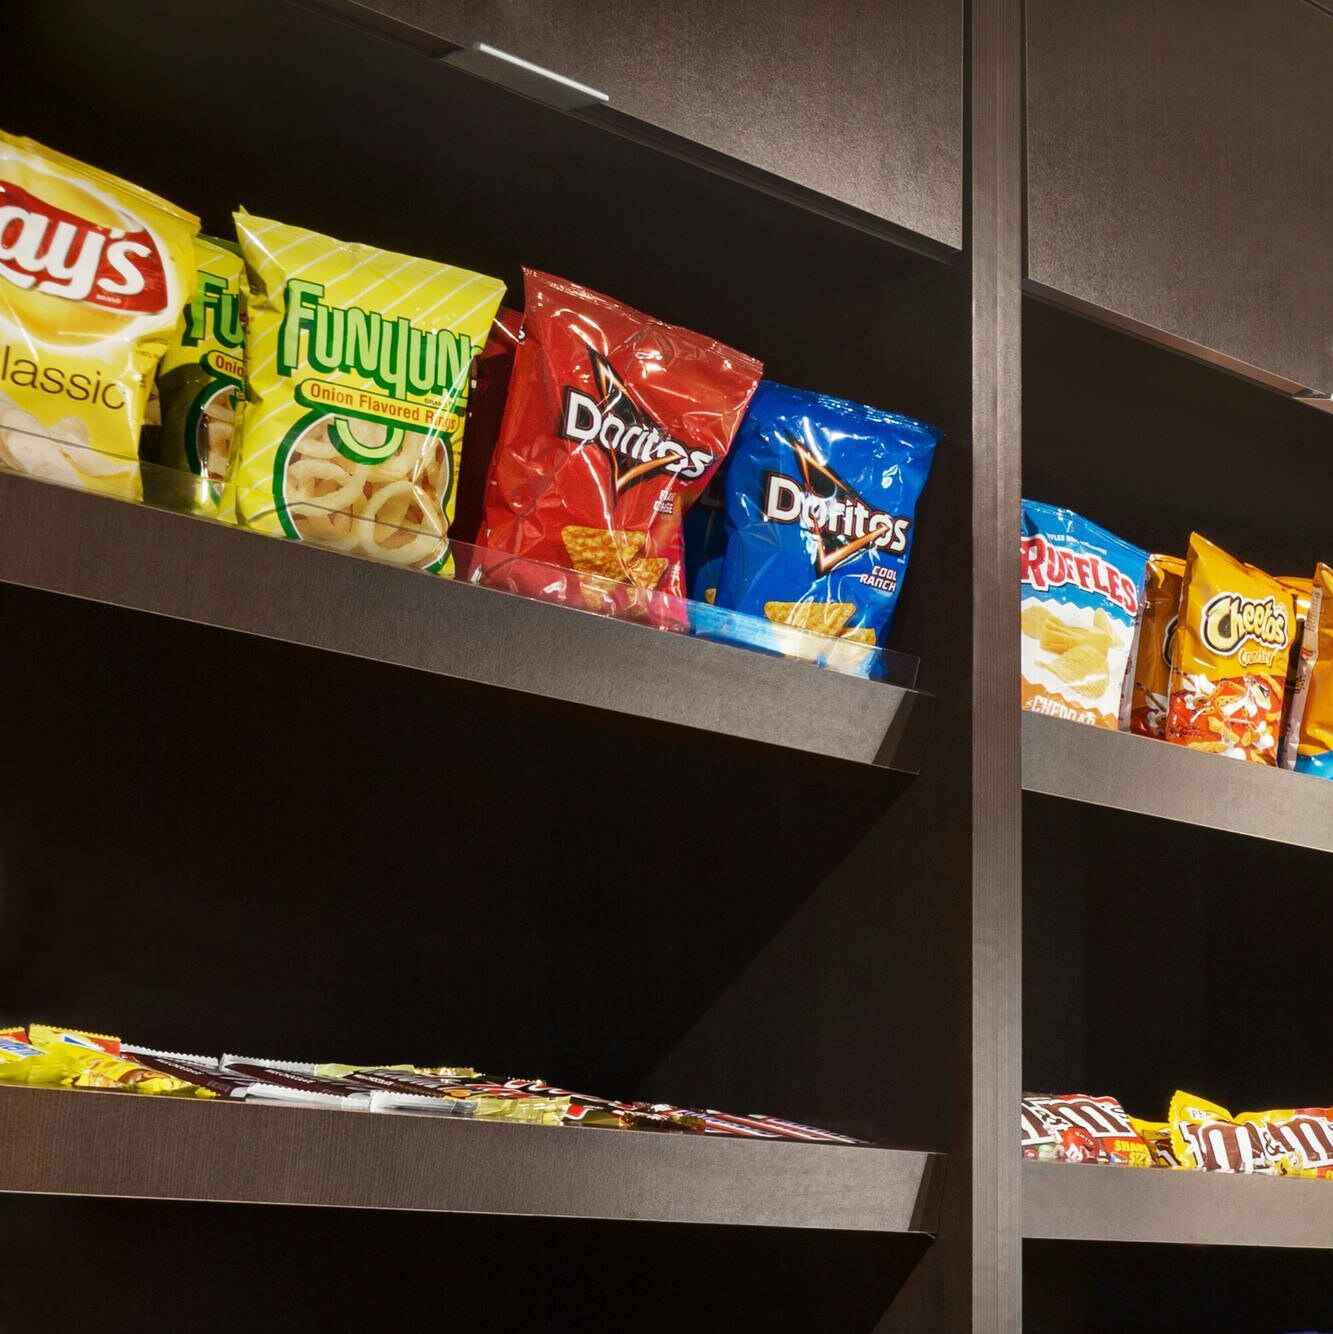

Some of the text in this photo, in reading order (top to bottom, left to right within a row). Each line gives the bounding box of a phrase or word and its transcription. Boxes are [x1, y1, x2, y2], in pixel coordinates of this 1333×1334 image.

[0, 205, 151, 300] ay's
[0, 345, 126, 409] lassic
[310, 383, 354, 405] Onion
[359, 396, 420, 421] Flavored
[566, 391, 713, 478] Doritos
[767, 473, 909, 552] Doritos
[860, 574, 897, 592] RANCH
[873, 565, 897, 581] COOL
[1021, 537, 1138, 614] RUFFLES
[1206, 595, 1287, 653] Cheetos
[1239, 648, 1275, 667] Crunchy
